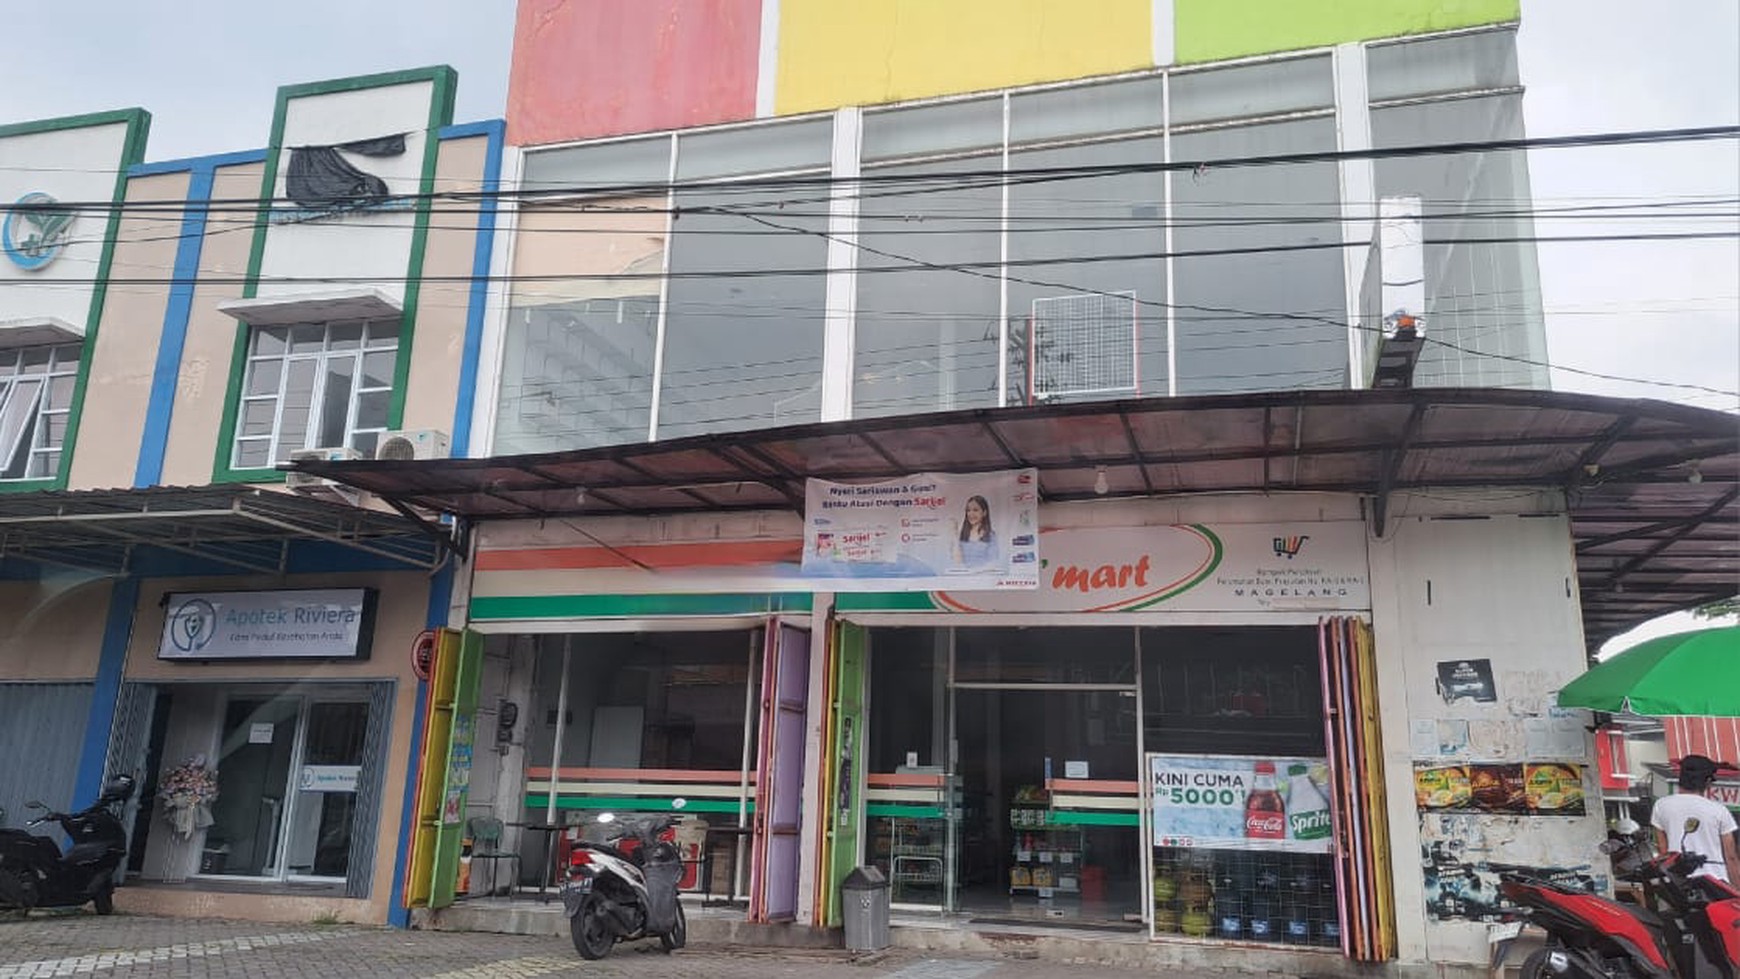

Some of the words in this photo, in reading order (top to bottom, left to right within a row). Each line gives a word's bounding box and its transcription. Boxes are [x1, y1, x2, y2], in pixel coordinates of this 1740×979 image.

[857, 485, 900, 495] Sariawan
[876, 499, 912, 508] Dengan
[1234, 588, 1348, 597] MAGELANG
[226, 609, 288, 626] Apotek
[294, 607, 356, 624] Riviera
[1155, 773, 1188, 786] KINI
[1194, 774, 1244, 787] CUMA
